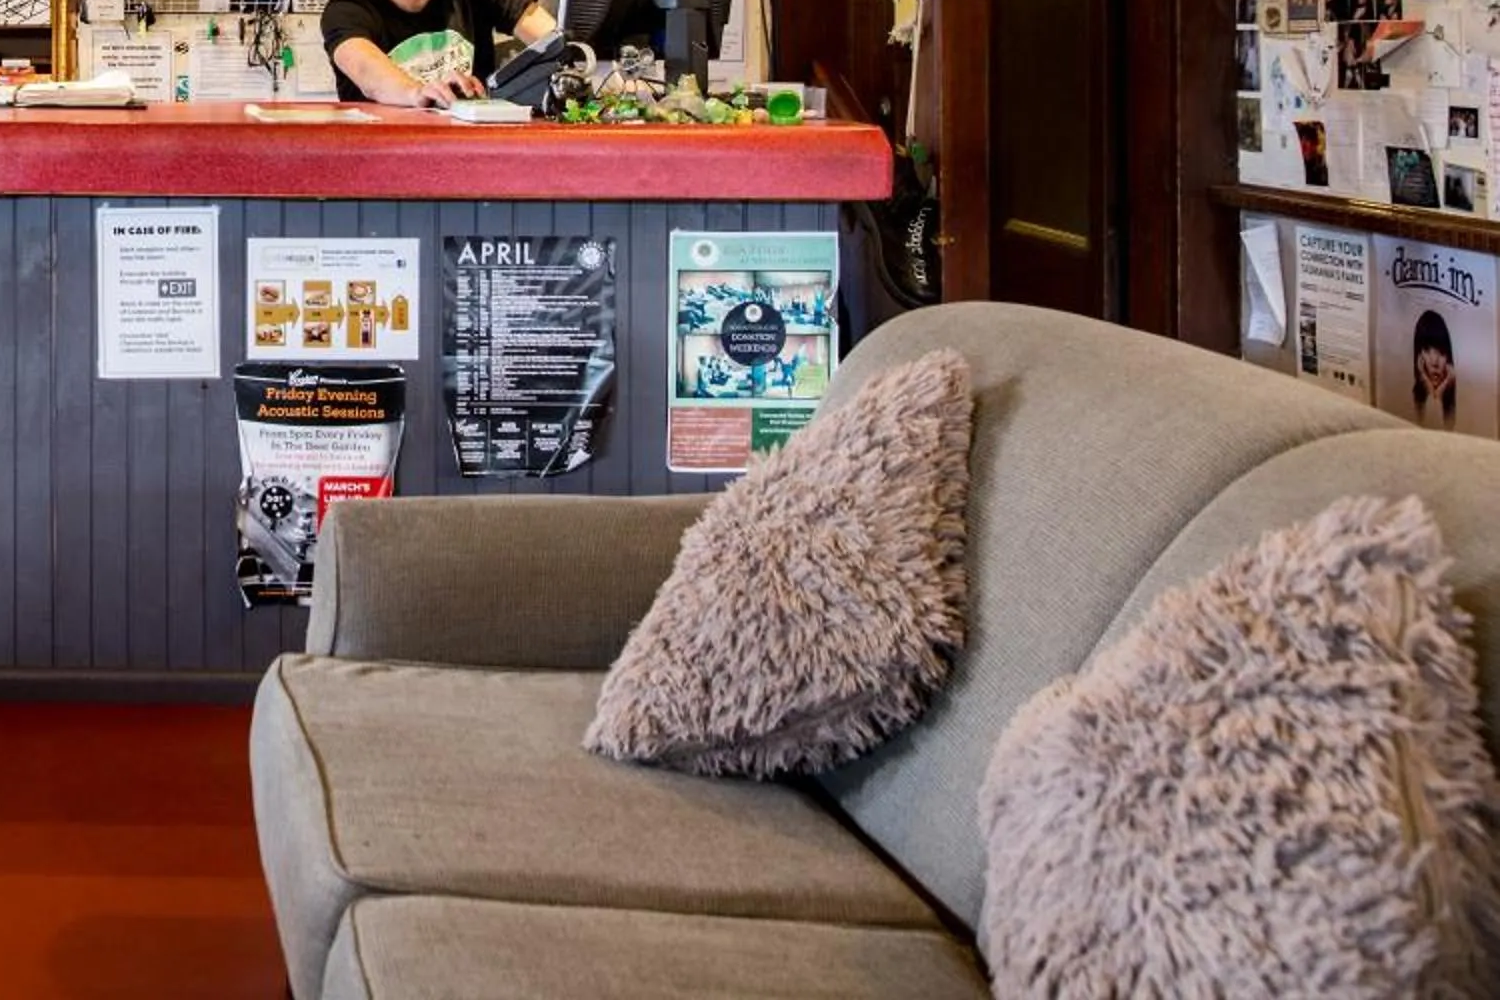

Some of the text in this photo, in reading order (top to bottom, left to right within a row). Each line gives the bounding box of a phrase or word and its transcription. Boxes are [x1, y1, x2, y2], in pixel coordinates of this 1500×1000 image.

[113, 227, 125, 235] IN
[128, 227, 154, 235] CASE
[157, 226, 171, 235] OF
[457, 242, 535, 265] APRIL
[1300, 234, 1364, 257] CAPTURE YOUR
[1300, 249, 1346, 268] CONNECTION
[168, 282, 194, 295] EXIT
[266, 387, 377, 405] Friday Evening
[257, 404, 385, 419] Acoustic Sessions
